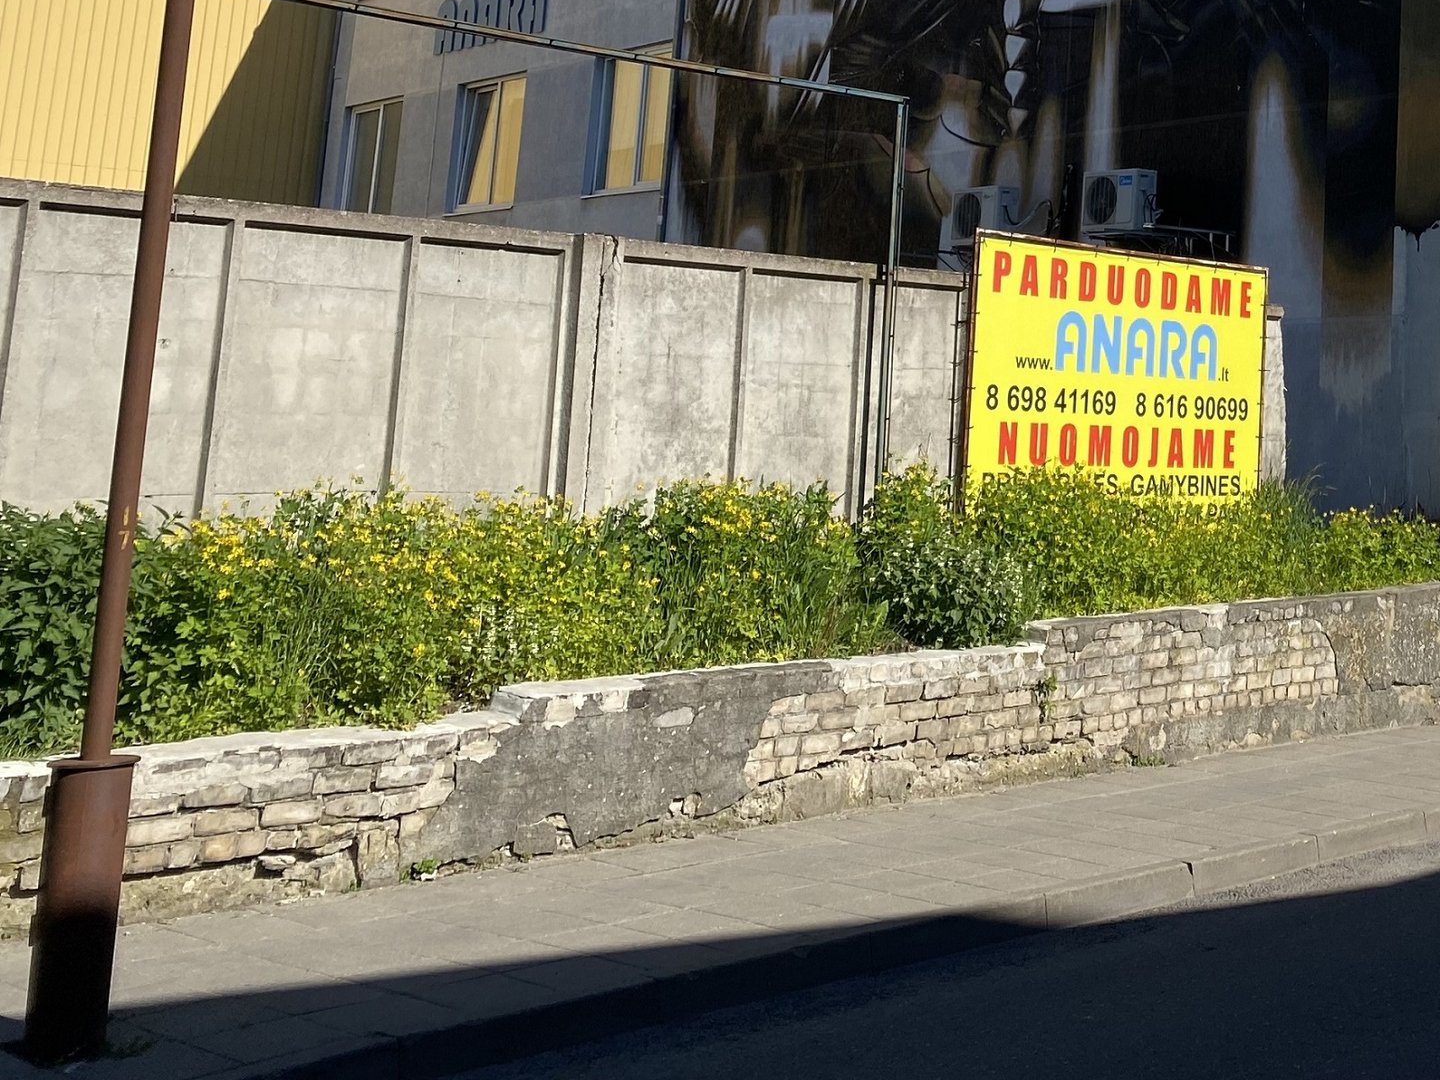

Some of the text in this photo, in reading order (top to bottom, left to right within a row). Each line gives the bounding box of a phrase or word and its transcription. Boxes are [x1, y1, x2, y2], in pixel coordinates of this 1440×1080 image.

[992, 250, 1252, 319] PARDUODAME
[985, 384, 1249, 421] 8 698 41169 8 616 90699
[997, 421, 1235, 469] NUOMOJAME
